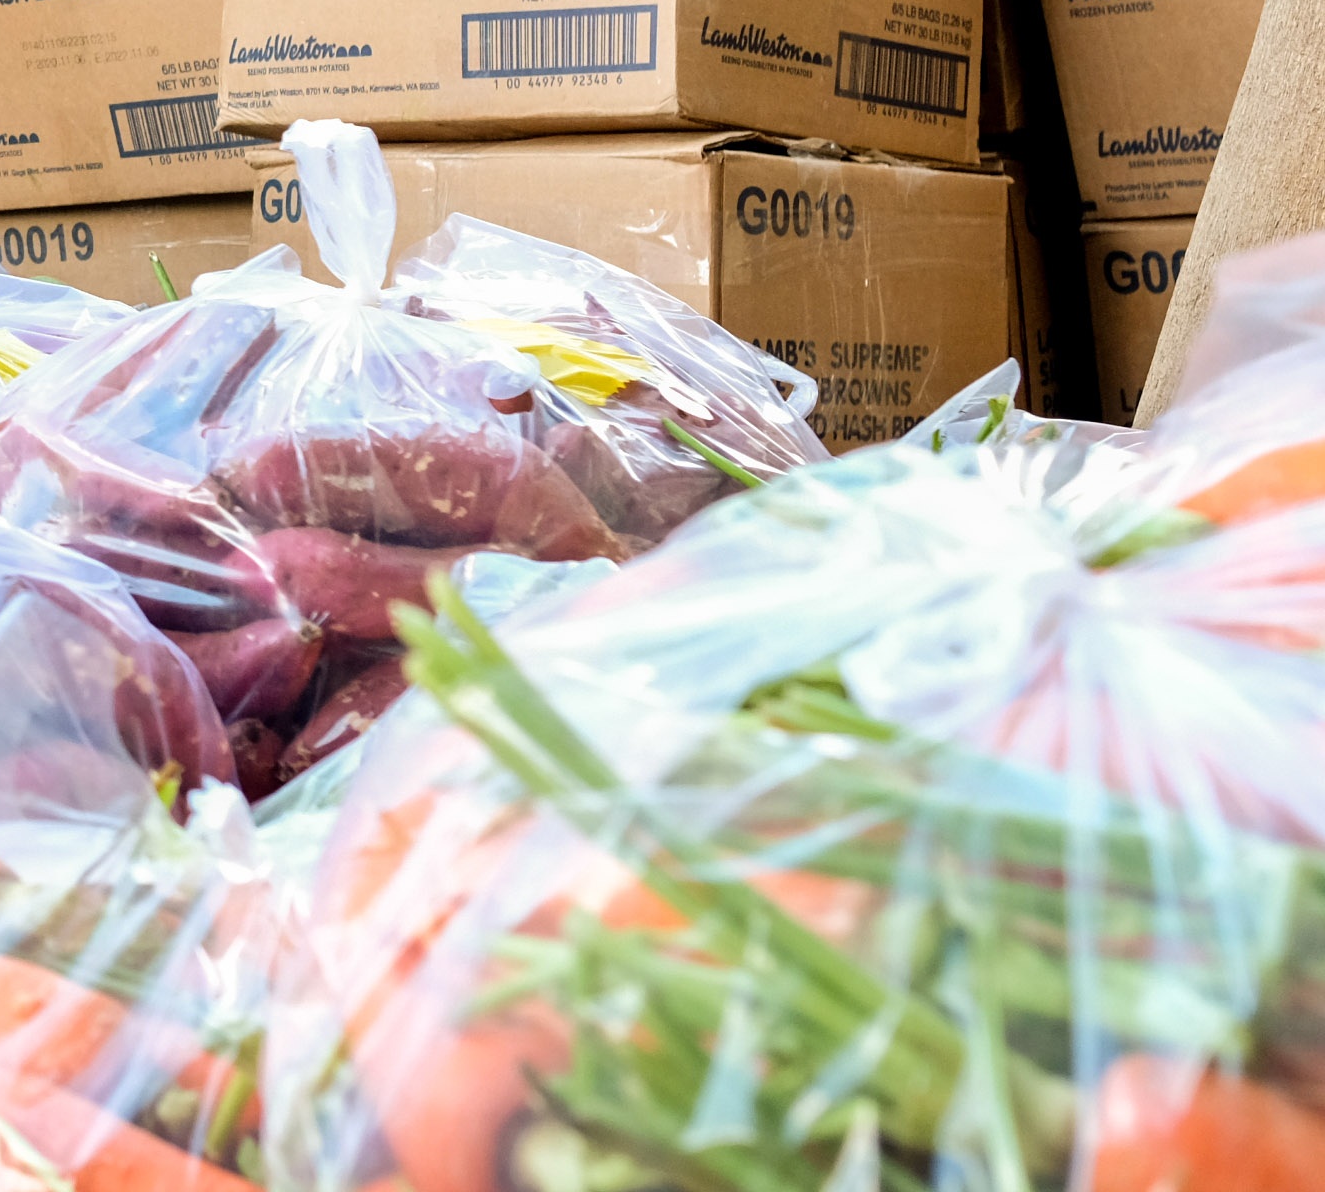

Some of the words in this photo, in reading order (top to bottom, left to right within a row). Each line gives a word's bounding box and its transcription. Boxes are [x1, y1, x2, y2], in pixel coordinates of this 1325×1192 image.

[179, 62, 192, 73] LB
[157, 79, 177, 92] NET
[179, 78, 196, 89] WT
[199, 76, 211, 87] 30
[1098, 125, 1224, 158] LambWesto
[736, 185, 856, 240] G0019
[832, 416, 887, 442] HASH
